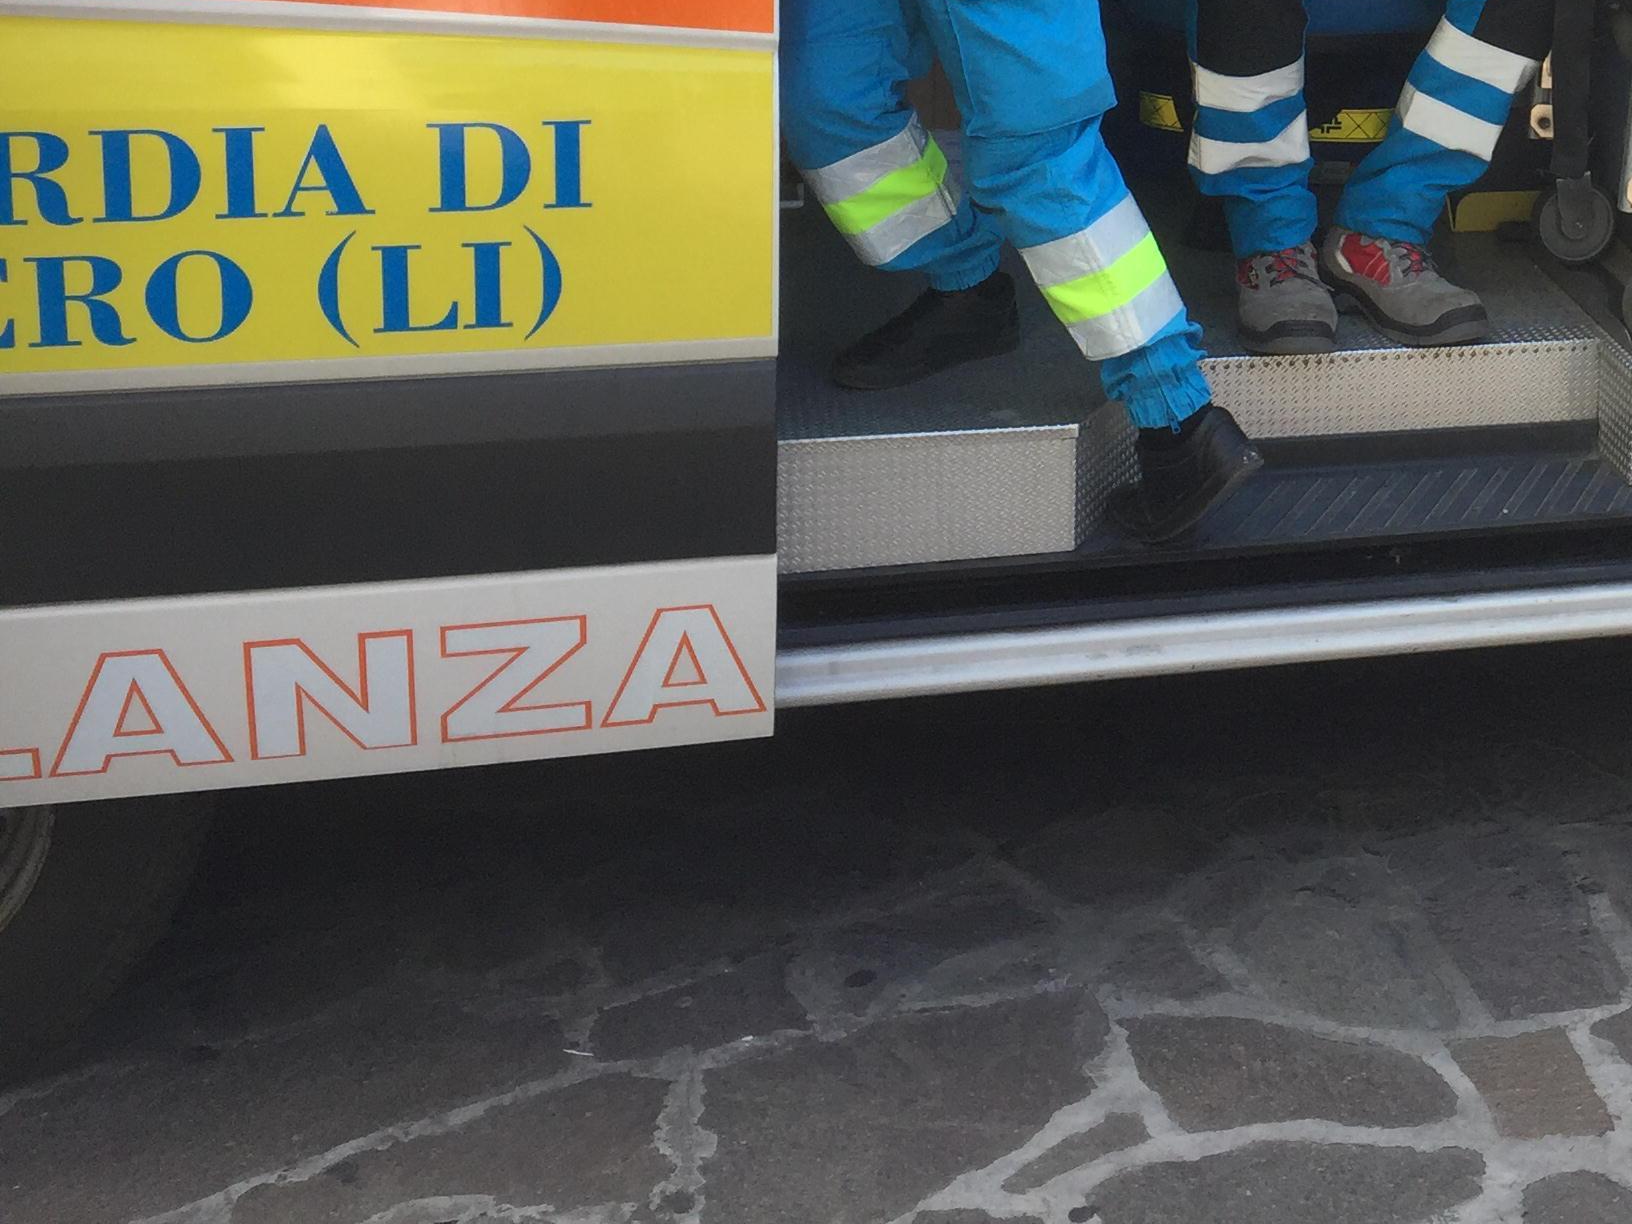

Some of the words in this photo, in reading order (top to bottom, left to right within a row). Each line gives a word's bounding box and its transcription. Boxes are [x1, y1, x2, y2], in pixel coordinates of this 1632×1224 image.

[0, 123, 375, 226] RDIA
[426, 120, 592, 213] DI
[0, 249, 253, 350] RO
[318, 225, 562, 348] (LI)
[0, 604, 767, 780] ANZA
